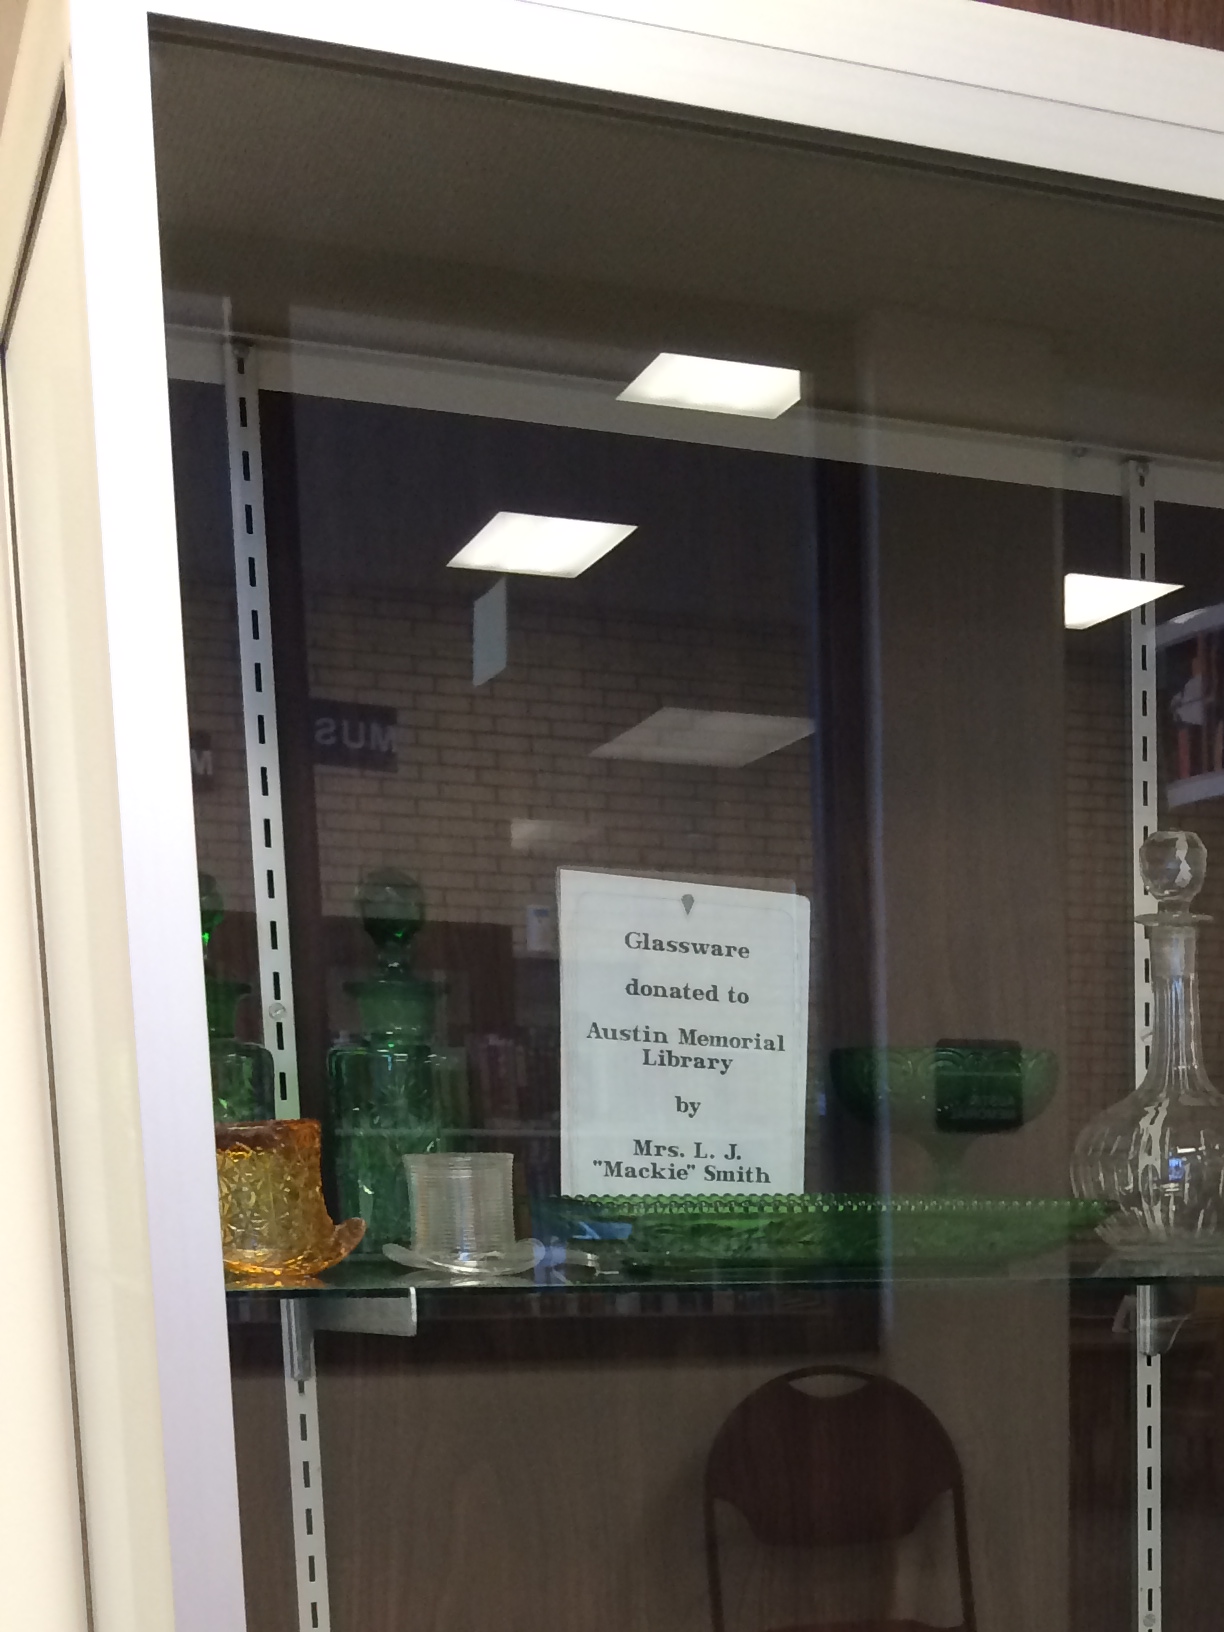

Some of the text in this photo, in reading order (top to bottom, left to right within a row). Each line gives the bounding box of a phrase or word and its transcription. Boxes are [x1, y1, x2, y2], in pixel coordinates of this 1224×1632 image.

[624, 931, 750, 959] Glassware
[624, 977, 750, 1005] donated to
[586, 1021, 786, 1052] Austin Memorial
[642, 1048, 734, 1076] Library
[674, 1095, 702, 1119] by
[632, 1138, 742, 1161] Mrs. L. J.
[592, 1159, 771, 1184] "Mackie" Smith
